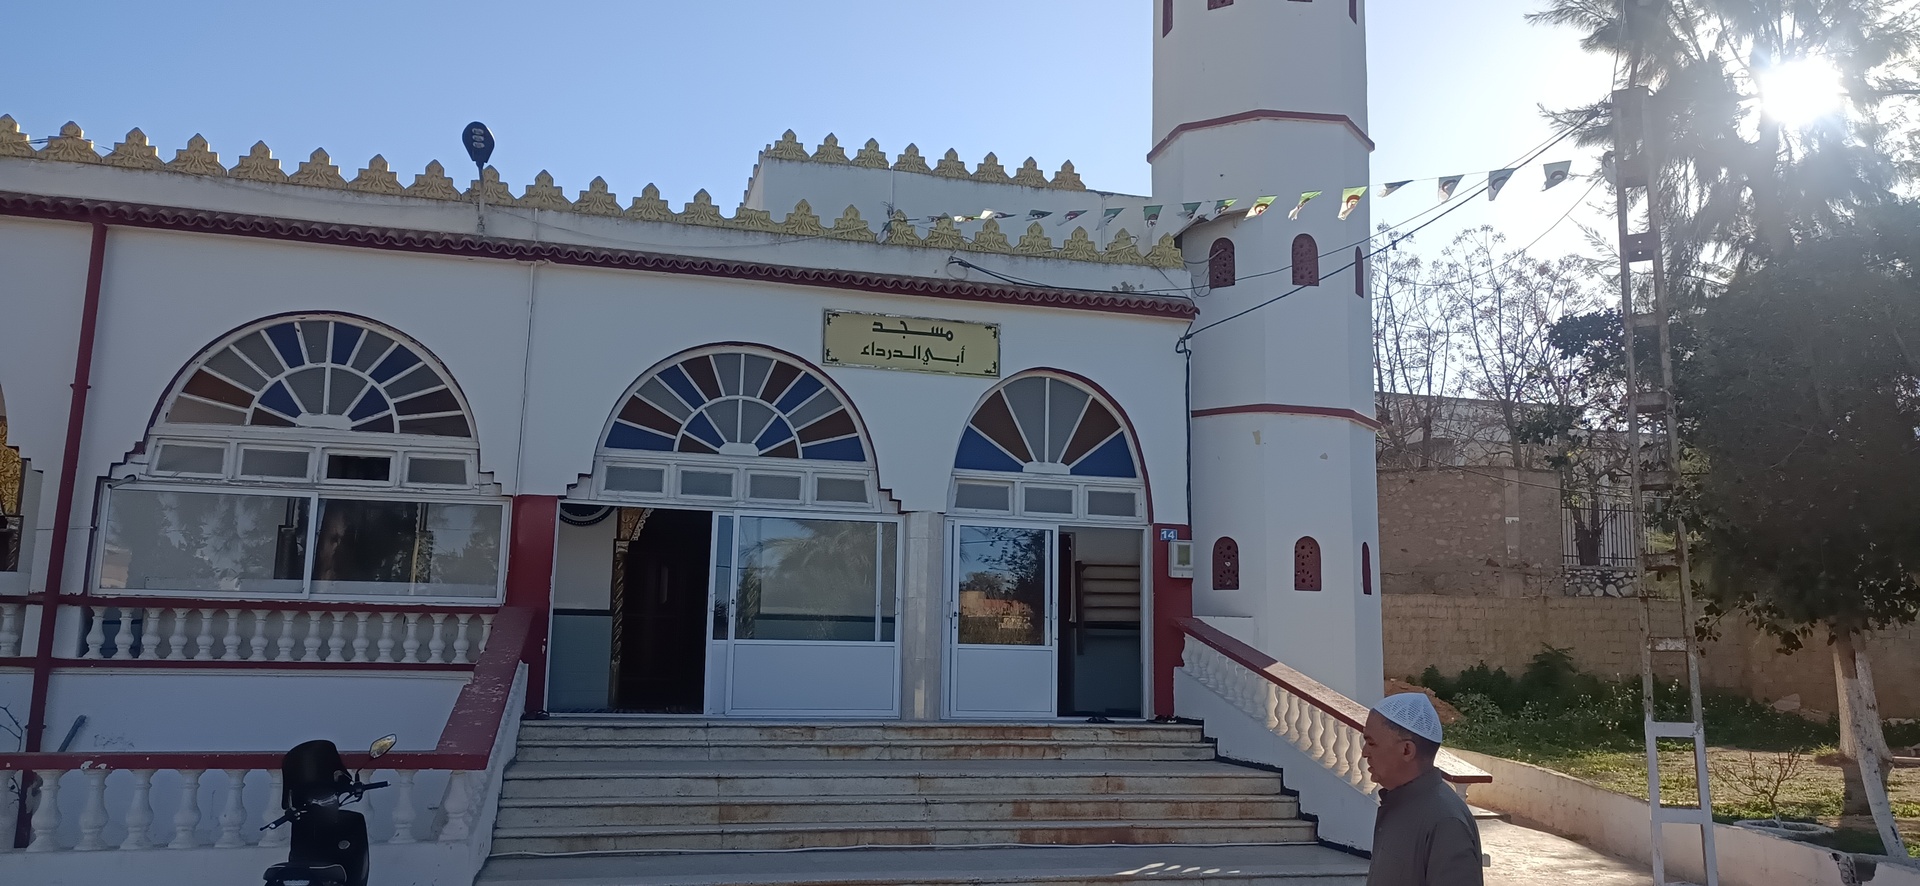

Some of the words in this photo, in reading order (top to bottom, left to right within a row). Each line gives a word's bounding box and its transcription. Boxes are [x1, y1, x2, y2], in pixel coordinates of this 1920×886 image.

[872, 320, 954, 341] مسجد
[860, 341, 921, 360] الدرداء
[921, 345, 966, 366] أبي
[1161, 530, 1175, 539] 14
